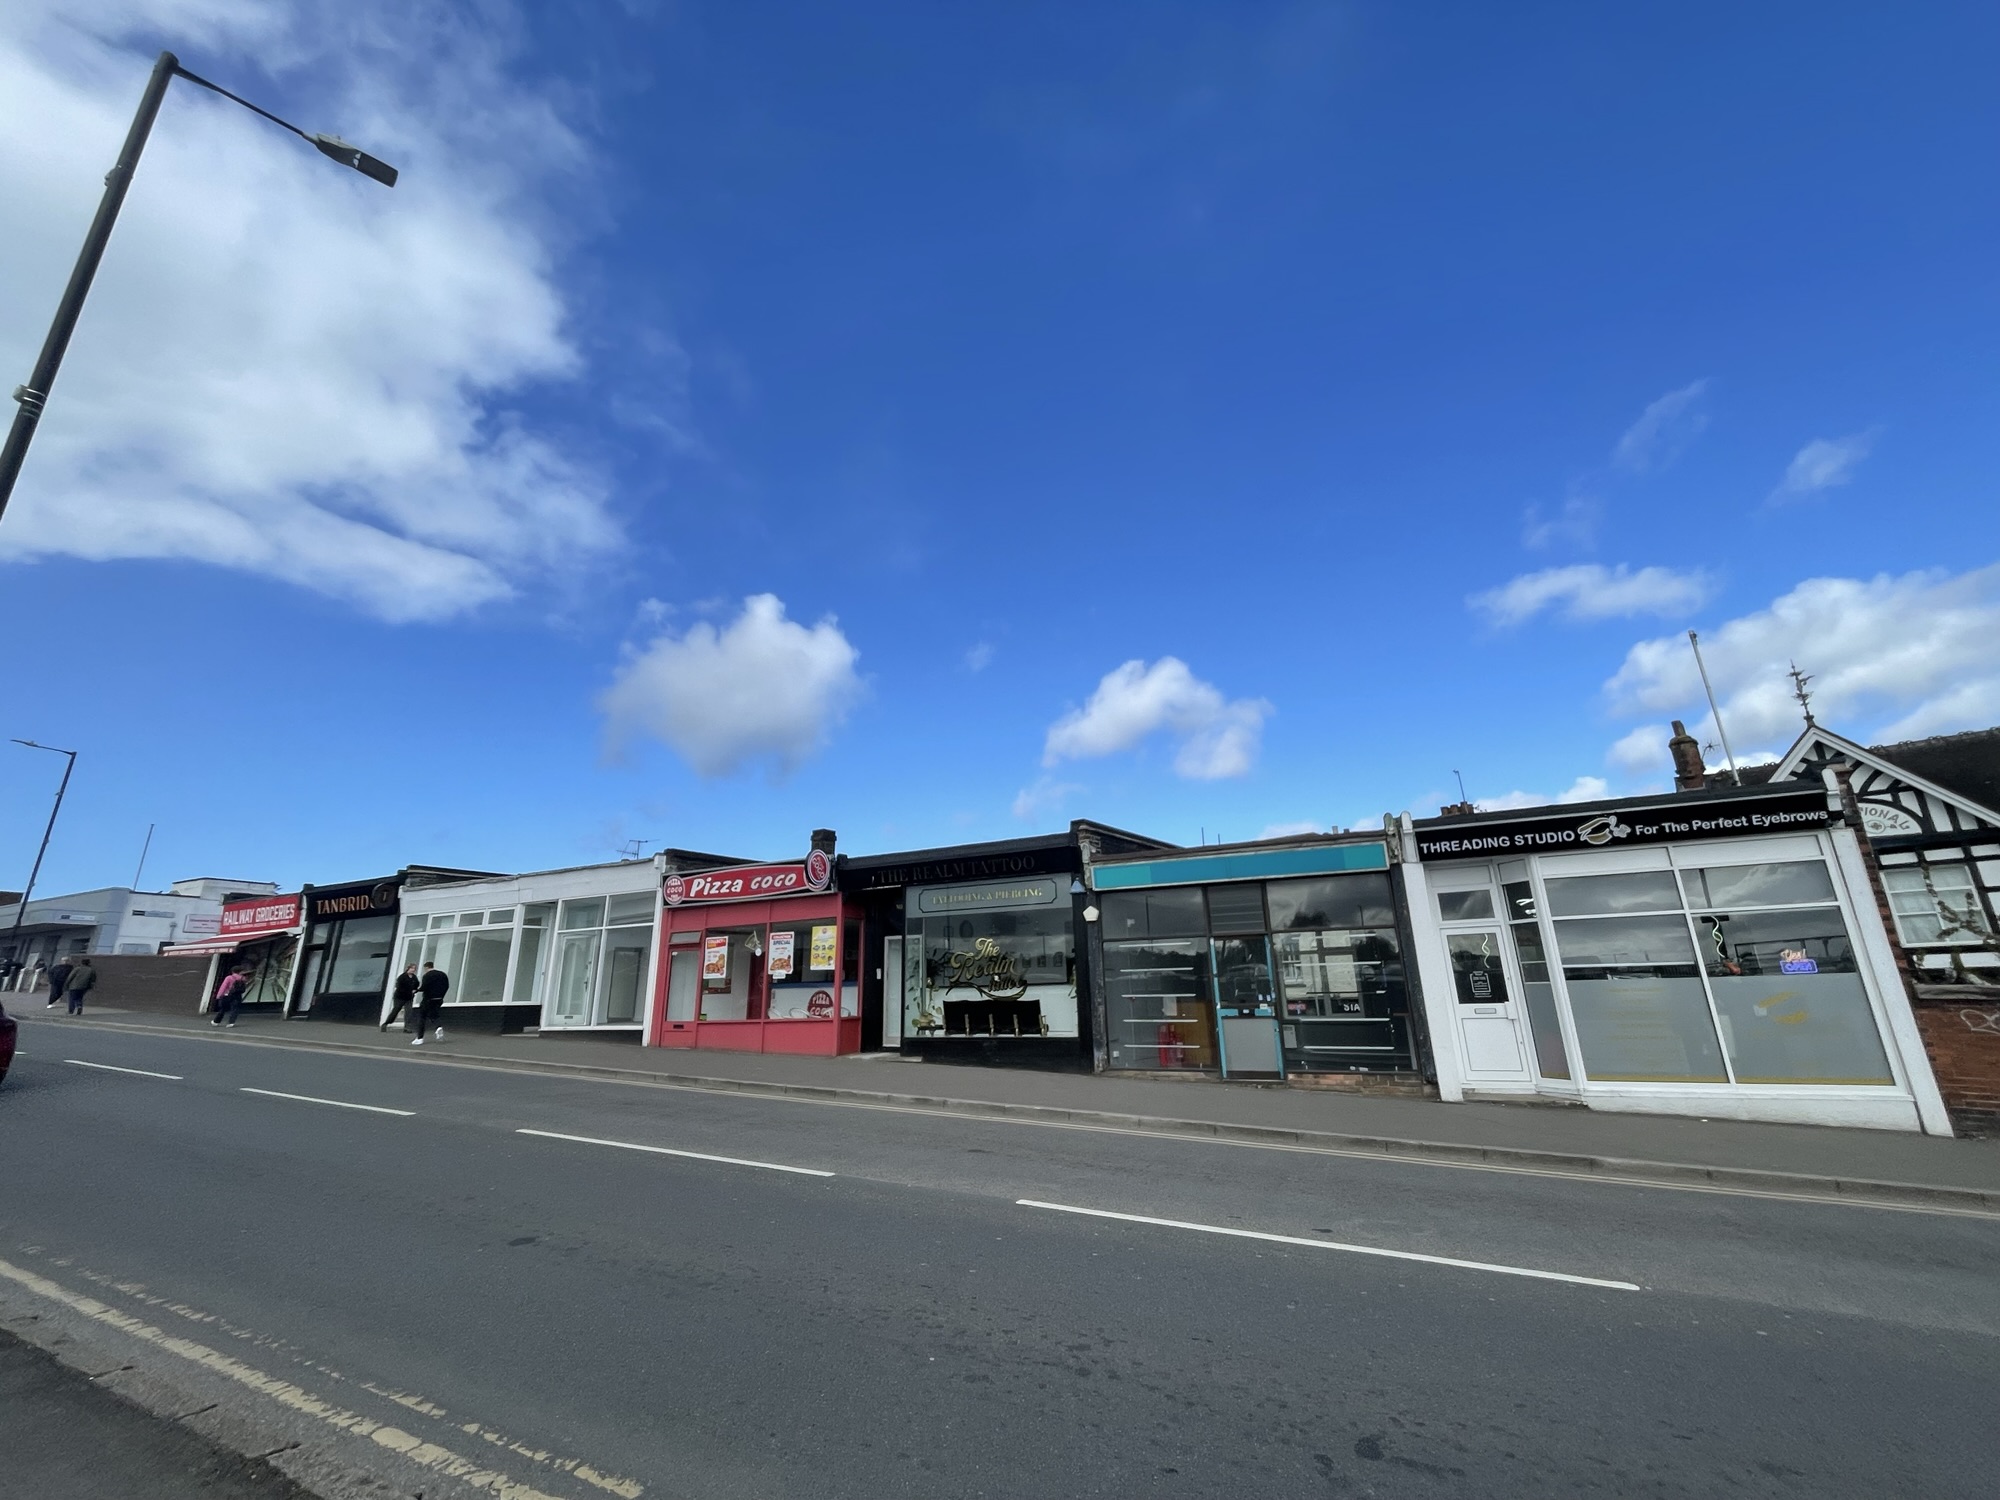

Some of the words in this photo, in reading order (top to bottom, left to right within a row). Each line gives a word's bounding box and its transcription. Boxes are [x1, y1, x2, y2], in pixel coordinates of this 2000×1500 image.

[1635, 824, 1659, 836] For
[1662, 821, 1689, 833] The
[1692, 816, 1748, 831] Perfect
[1751, 810, 1828, 827] Eyebrows
[1420, 836, 1510, 854] THREADING
[1514, 830, 1575, 846] STUDIO
[877, 869, 908, 883] THE
[912, 862, 965, 880] REALM
[966, 855, 1035, 875] TATTOO
[689, 876, 743, 897] Pizza
[995, 887, 1042, 899] PIERCING
[223, 908, 255, 926] RAILWAY
[255, 903, 296, 922] GROCERIES
[316, 894, 373, 914] TANBRID
[975, 937, 1000, 960] The
[950, 951, 1021, 982] Realm
